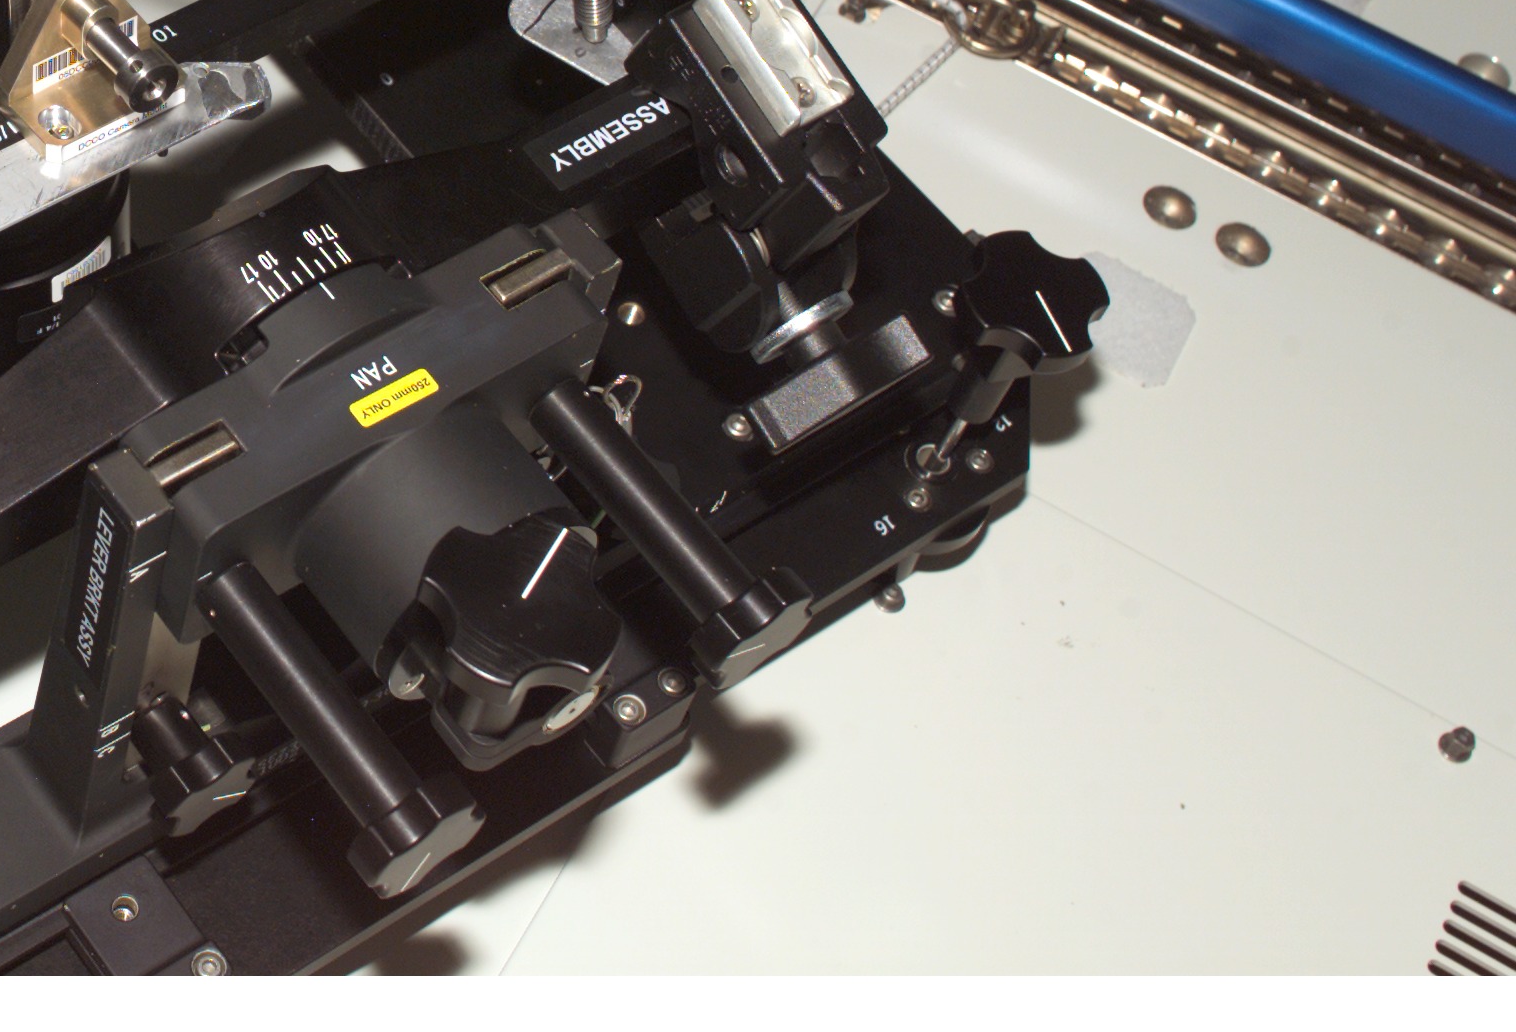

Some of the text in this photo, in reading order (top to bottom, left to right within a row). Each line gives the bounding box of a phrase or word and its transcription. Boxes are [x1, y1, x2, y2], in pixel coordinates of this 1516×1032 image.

[106, 115, 139, 136] Camera
[549, 95, 671, 173] ASSEMBLY
[301, 228, 323, 246] 10
[318, 222, 339, 241] 17
[257, 250, 279, 270] 10
[349, 354, 398, 390] PAN
[361, 377, 430, 419] 250mm ONLY
[873, 515, 896, 538] 16
[75, 506, 114, 668] LEVER BRKT ASSY
